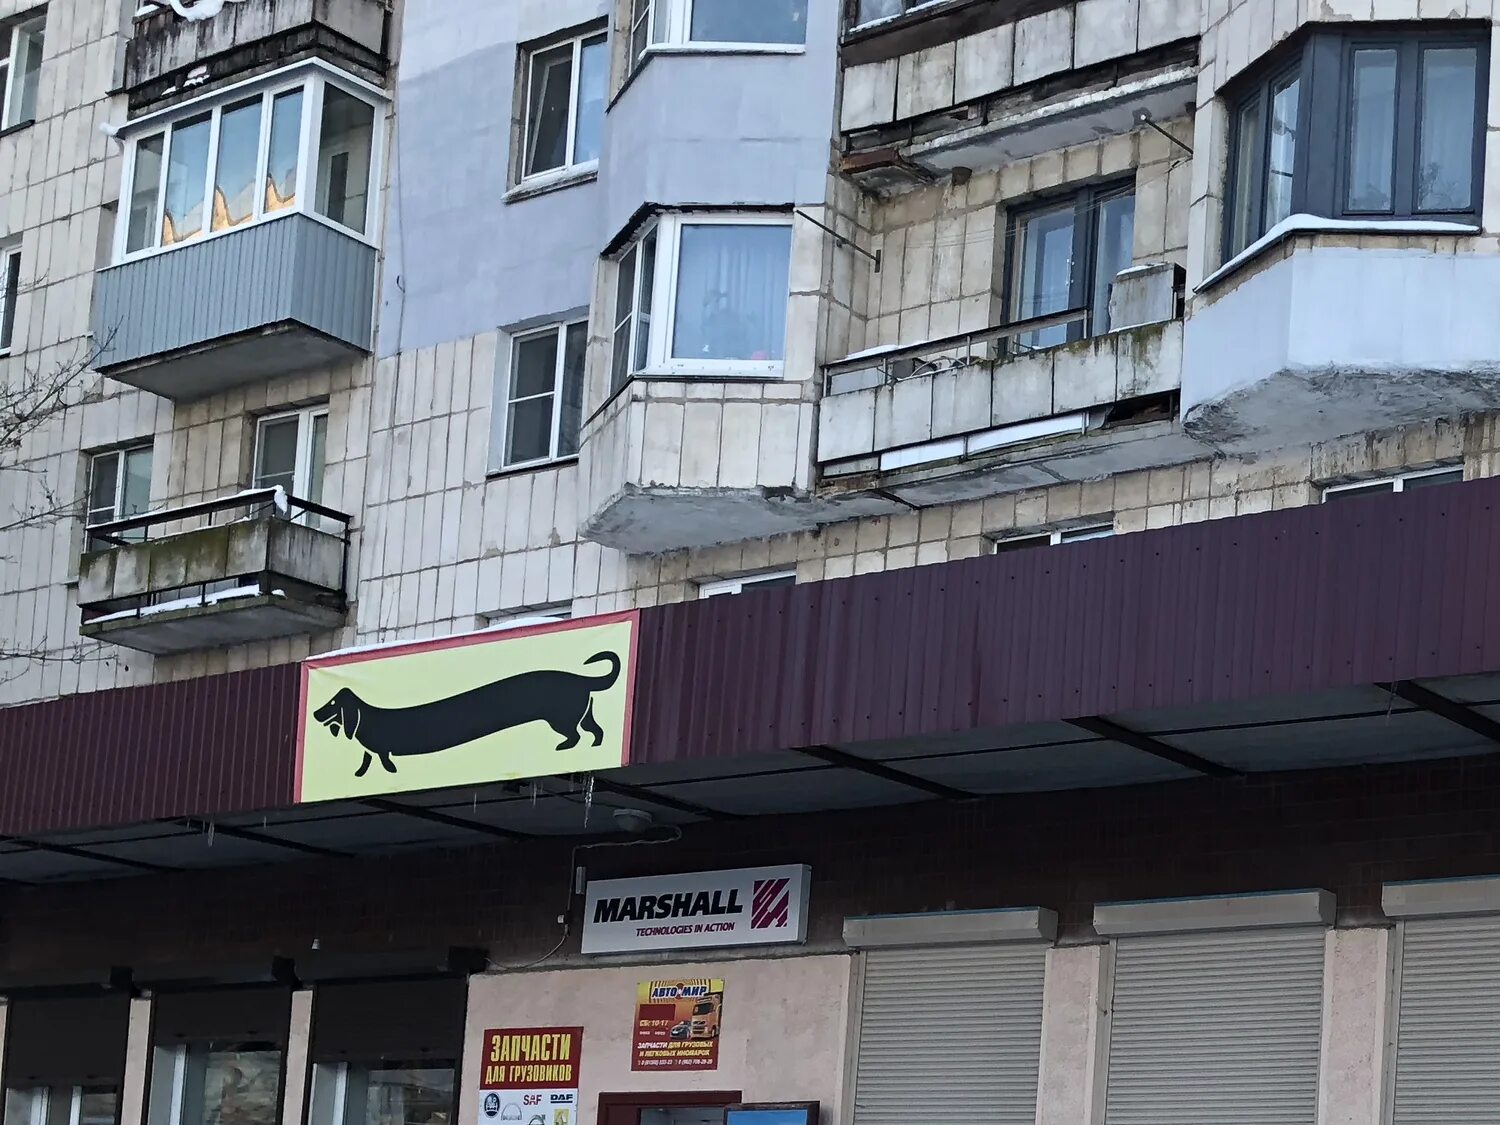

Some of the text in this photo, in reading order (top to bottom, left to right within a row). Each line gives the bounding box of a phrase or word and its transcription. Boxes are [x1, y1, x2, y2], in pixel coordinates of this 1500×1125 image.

[593, 889, 744, 923] MARSHALL
[636, 922, 736, 937] TECHNOLOGIES IN ACTION
[651, 986, 707, 997] АВТО МИР
[490, 1034, 571, 1062] ЗАПЧАСТИ
[637, 1041, 668, 1049] ЗАПЧАСТИ
[485, 1064, 572, 1085] ДЛЯ ГРУЗОВИКОВ
[523, 1094, 542, 1105] SAF
